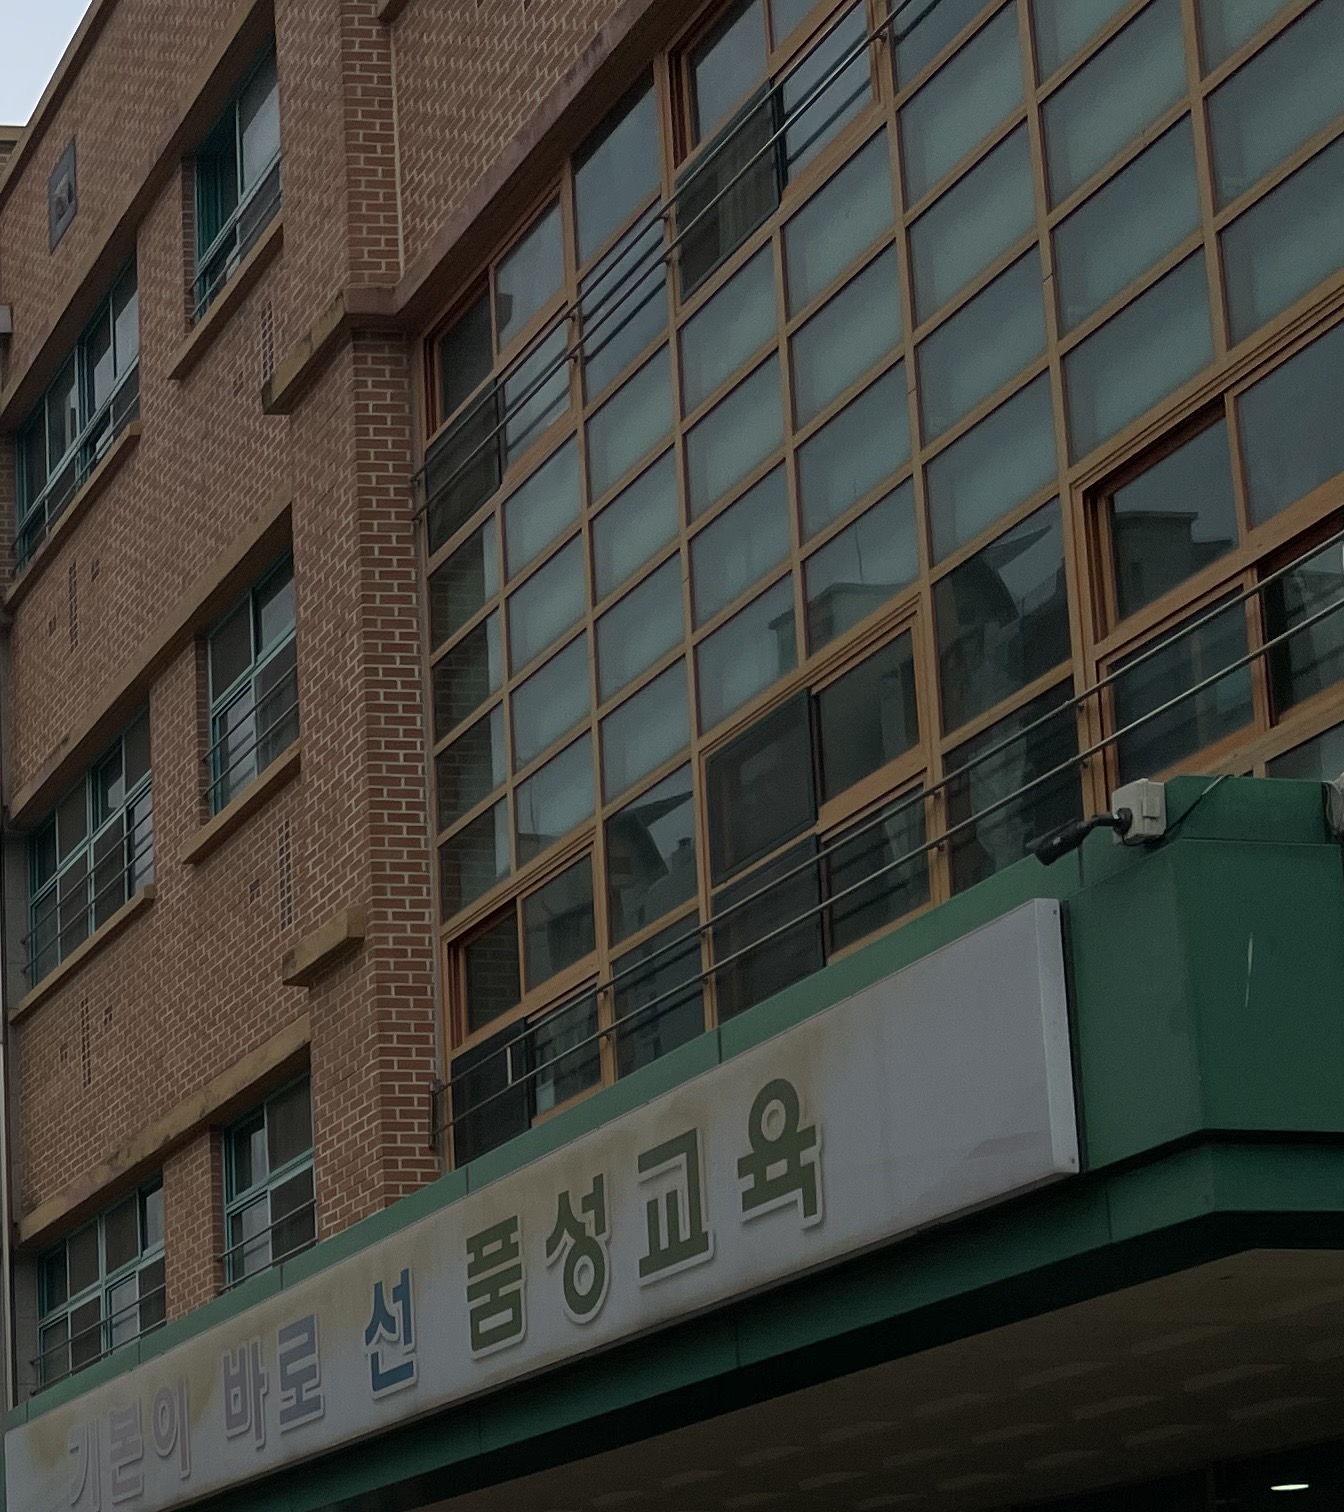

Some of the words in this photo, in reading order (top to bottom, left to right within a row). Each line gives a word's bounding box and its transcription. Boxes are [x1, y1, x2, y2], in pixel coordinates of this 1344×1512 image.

[223, 1315, 324, 1449] 바로
[364, 1268, 419, 1398] 선
[466, 1079, 823, 1358] 품성교육
